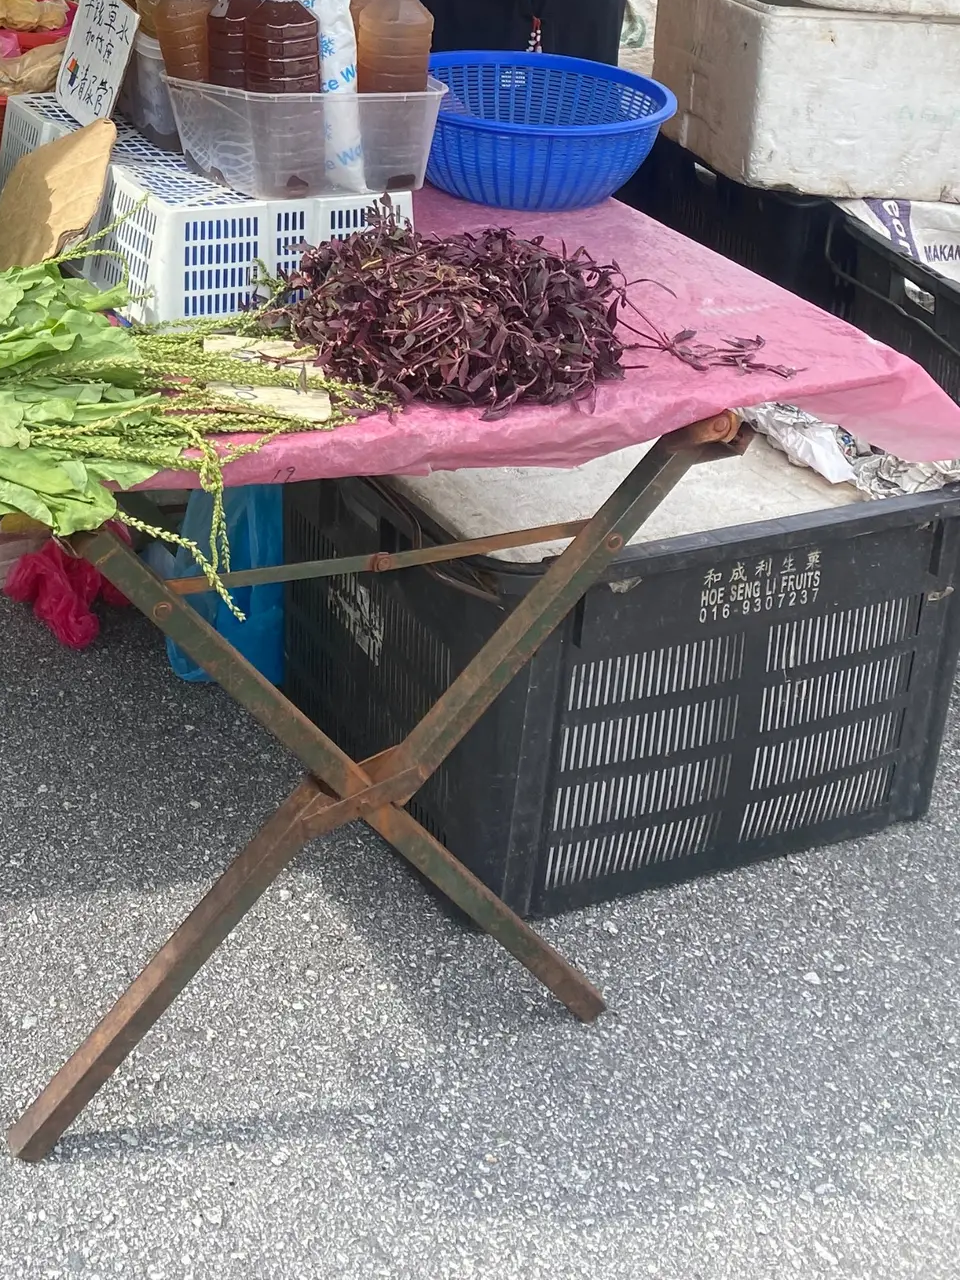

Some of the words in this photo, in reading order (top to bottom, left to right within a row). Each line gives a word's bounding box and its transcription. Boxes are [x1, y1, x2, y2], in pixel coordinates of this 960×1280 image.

[699, 588, 819, 623] 016-9307237
[700, 587, 725, 608] HOE
[730, 581, 761, 602] SENG
[766, 578, 777, 596] LI
[781, 571, 821, 594] FRUITS
